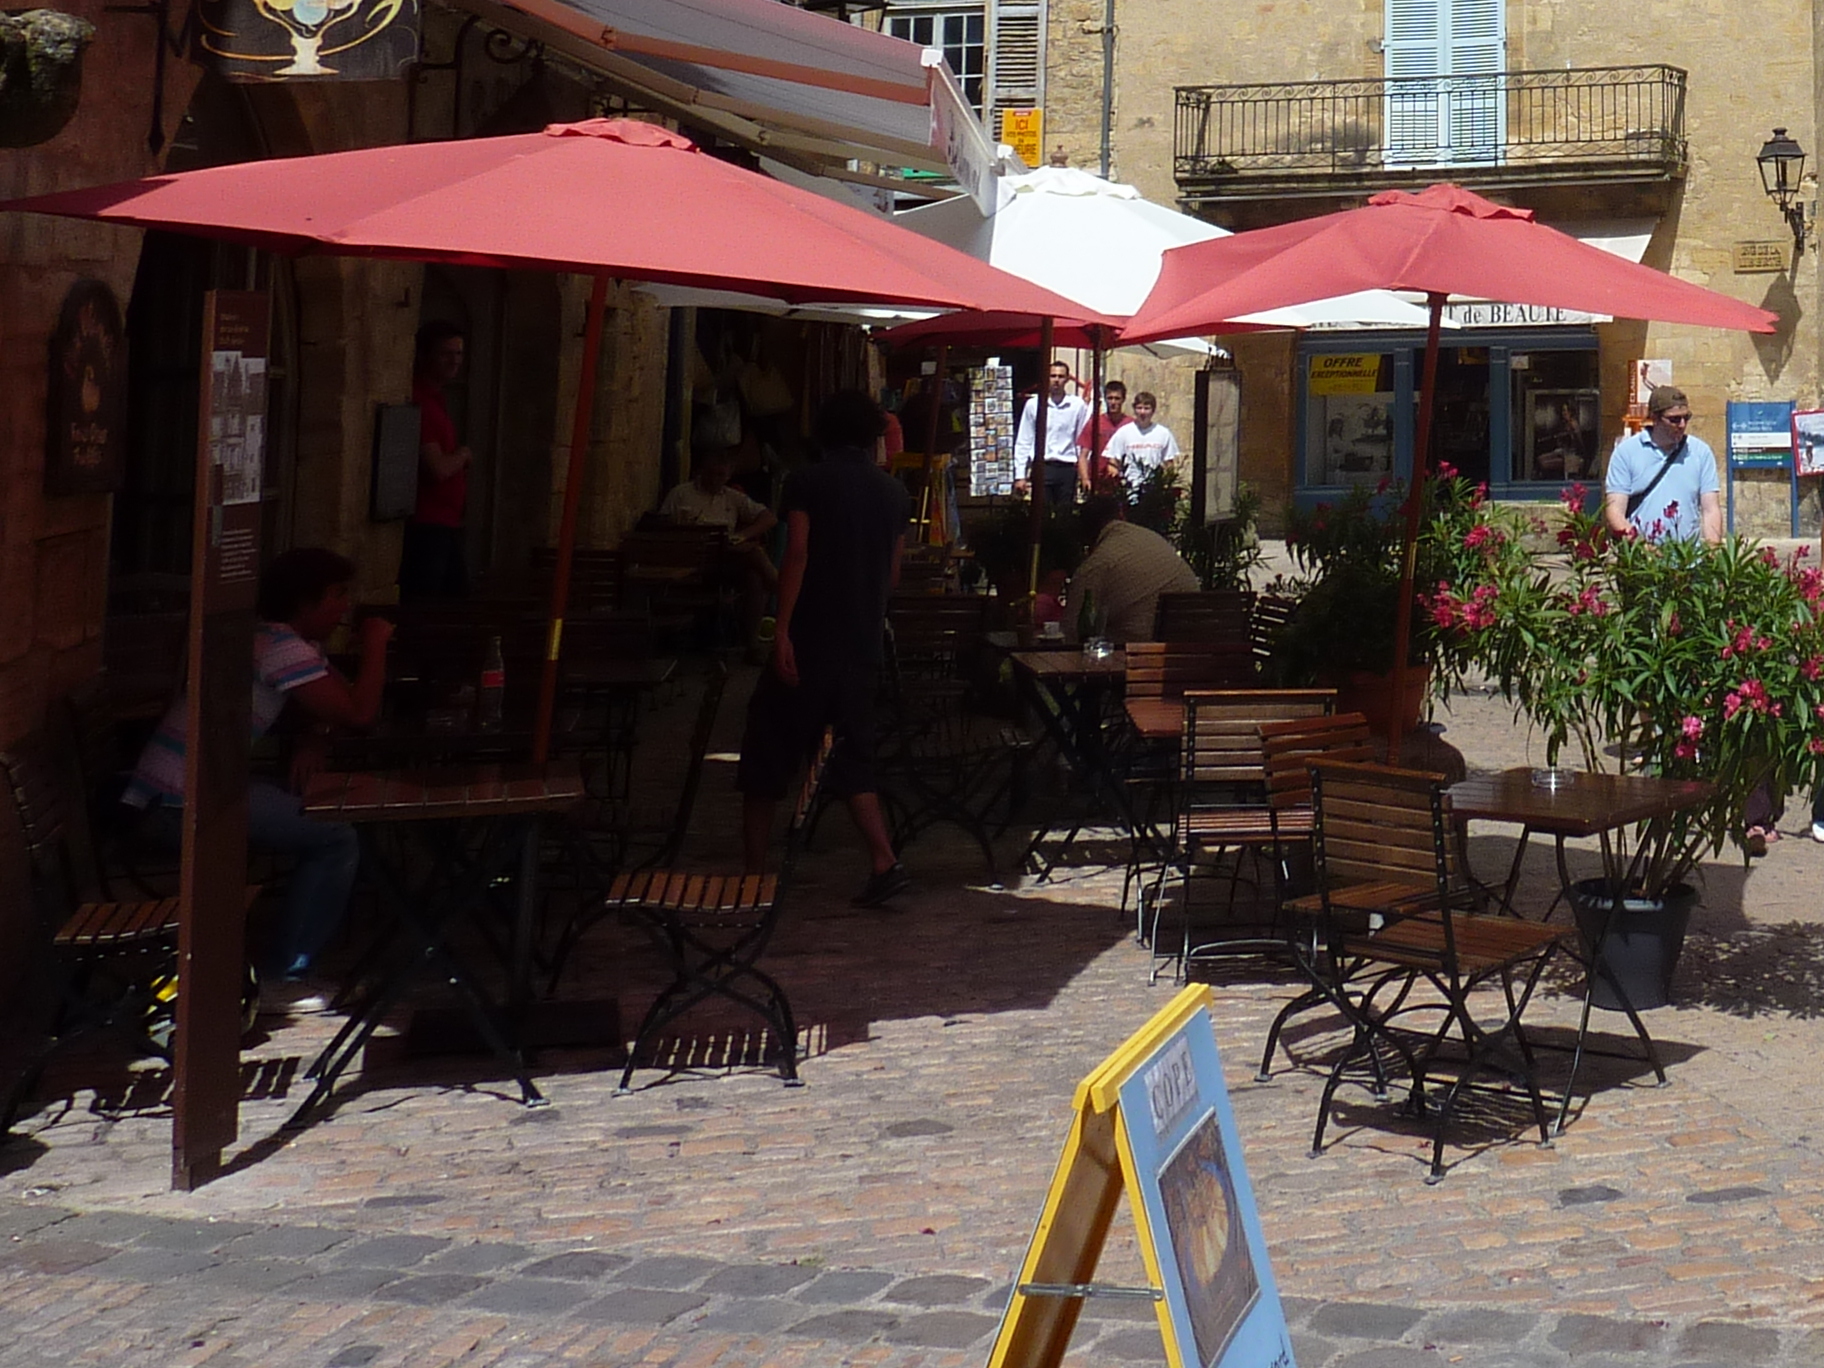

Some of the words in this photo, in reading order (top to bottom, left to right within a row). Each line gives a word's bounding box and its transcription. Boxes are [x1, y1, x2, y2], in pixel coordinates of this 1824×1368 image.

[1015, 119, 1029, 130] ICI
[1464, 306, 1483, 324] de
[1323, 357, 1364, 368] OFFRE
